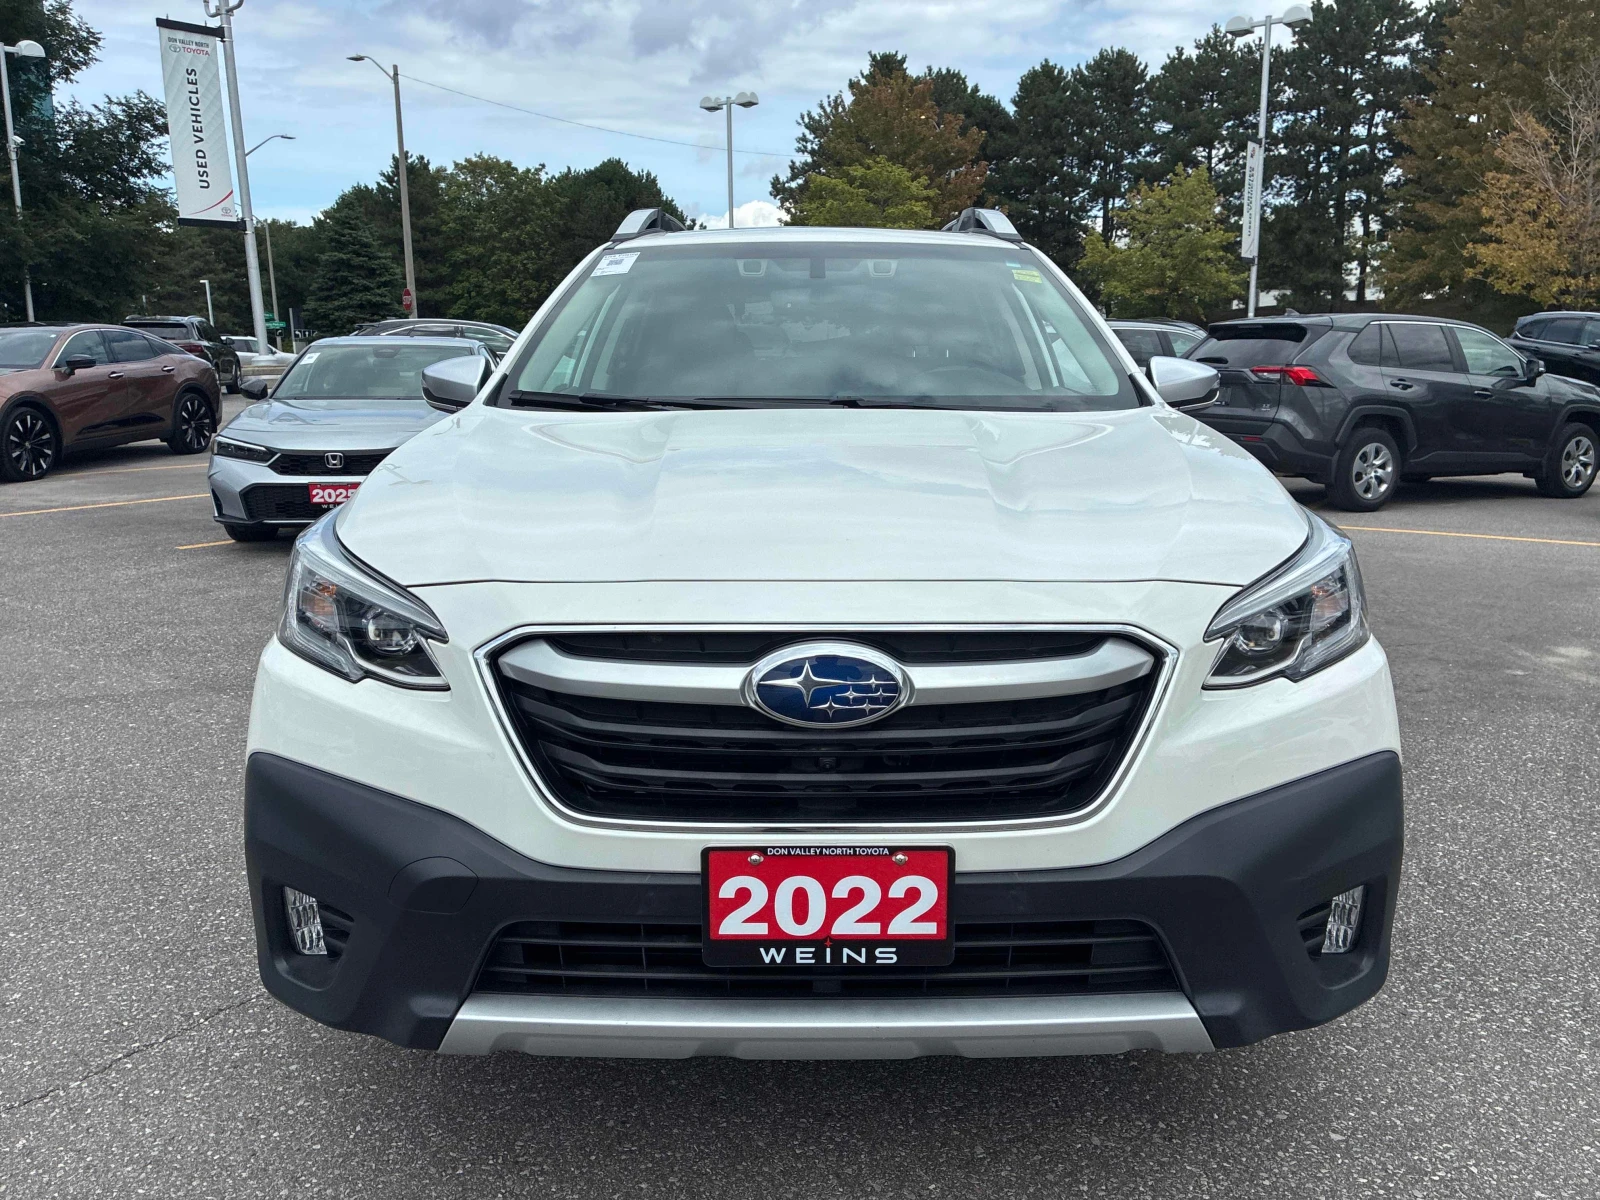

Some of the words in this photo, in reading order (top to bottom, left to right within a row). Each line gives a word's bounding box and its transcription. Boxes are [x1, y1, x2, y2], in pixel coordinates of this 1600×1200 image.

[178, 38, 194, 46] VALLEY
[182, 46, 210, 57] TOYOTA
[186, 67, 205, 144] VEHICLES
[195, 149, 211, 189] USED
[403, 296, 411, 304] STOP
[767, 847, 789, 856] DON
[789, 847, 821, 856] VALLEY
[822, 847, 855, 856] NORTH
[855, 847, 890, 856] TOYOTA
[718, 875, 939, 936] 2022
[759, 947, 898, 964] WEINS
